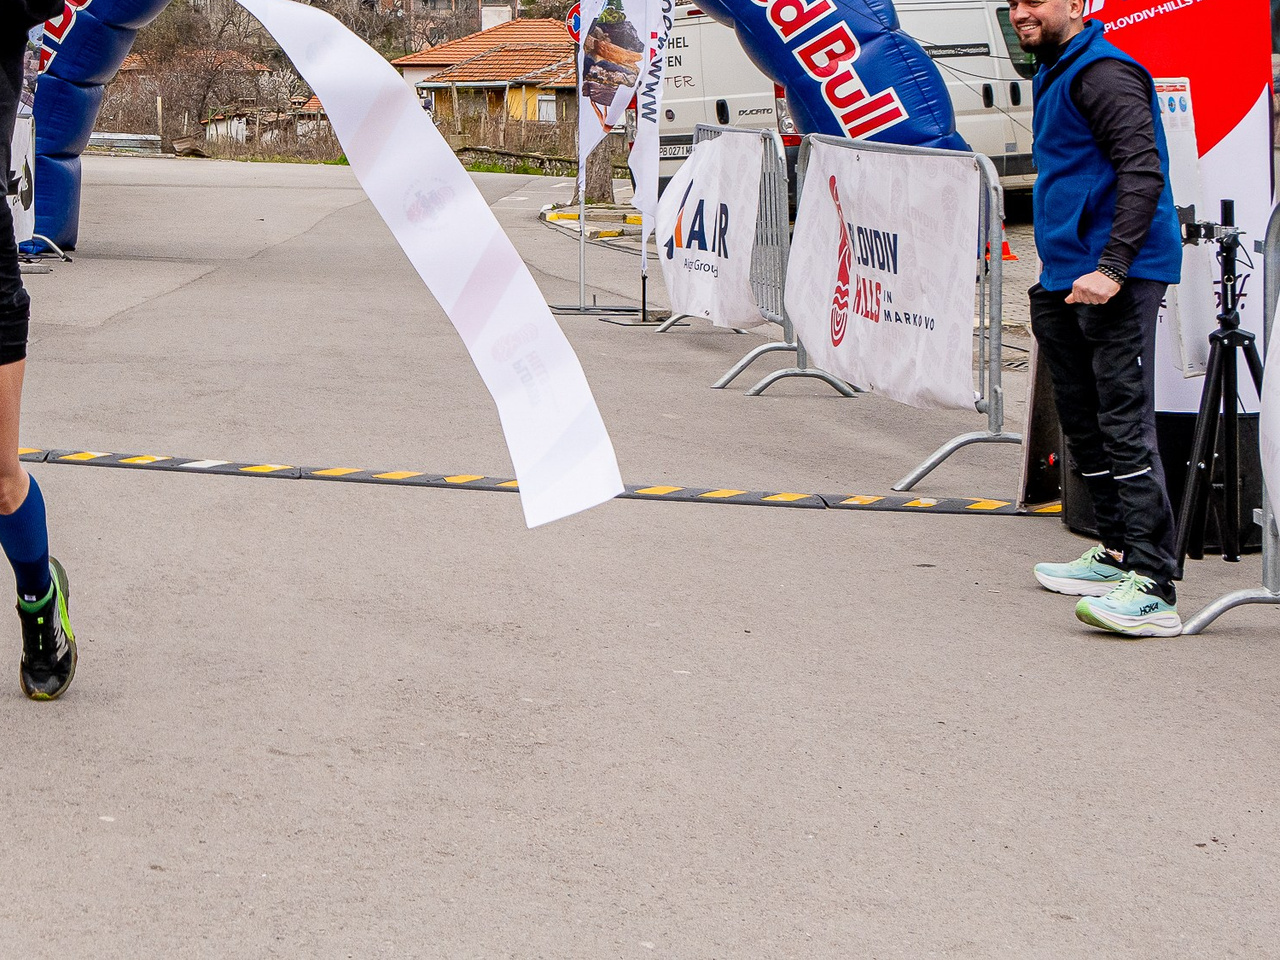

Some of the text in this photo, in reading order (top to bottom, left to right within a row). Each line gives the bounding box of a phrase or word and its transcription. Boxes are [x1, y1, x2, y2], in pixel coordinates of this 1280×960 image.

[665, 37, 689, 49] HEL
[665, 55, 682, 68] EN
[792, 21, 909, 141] Bull
[669, 146, 685, 156] 0271
[883, 290, 893, 304] IN
[1139, 602, 1159, 616] HOKA
